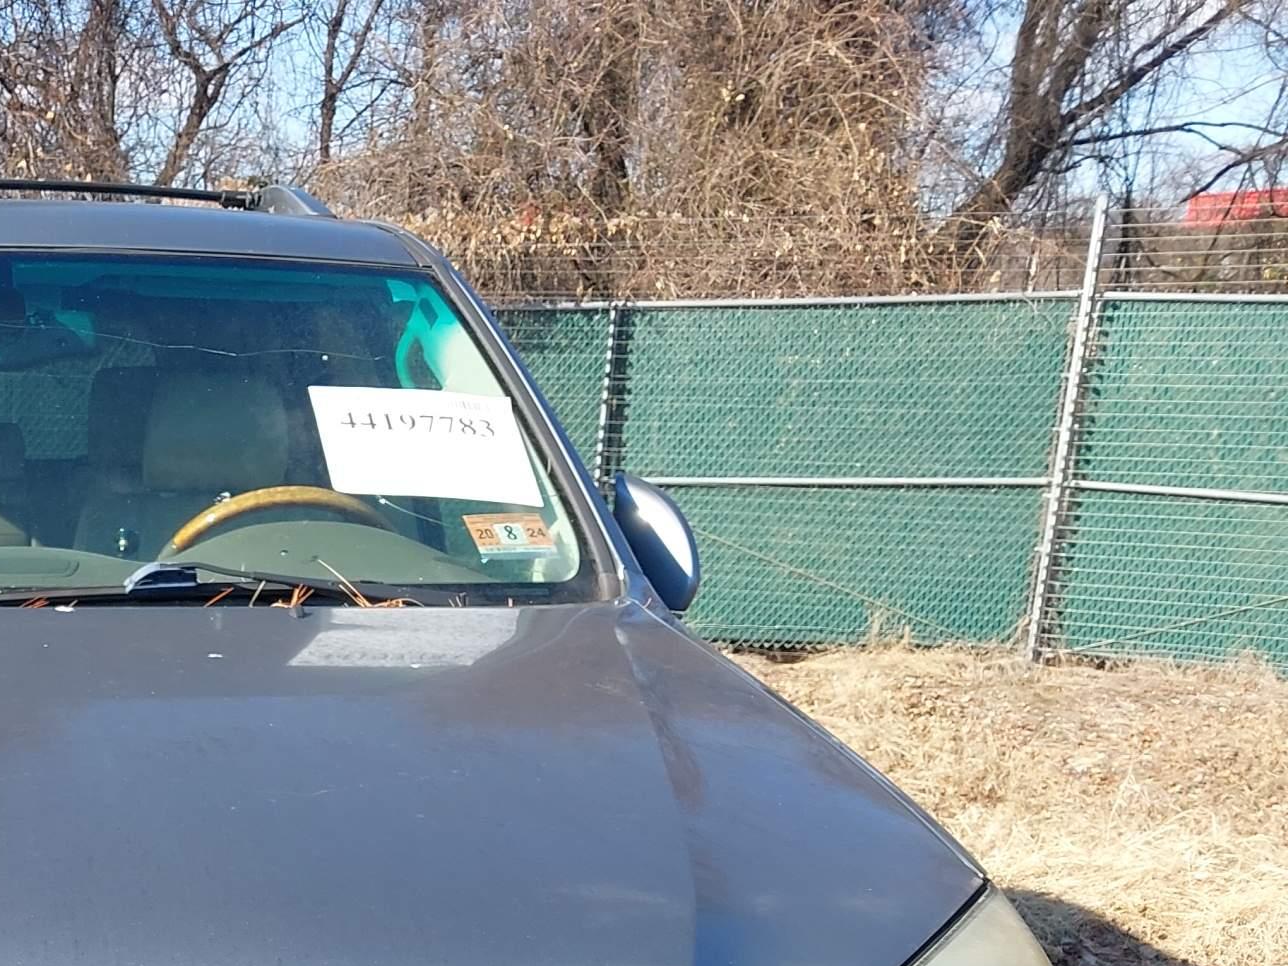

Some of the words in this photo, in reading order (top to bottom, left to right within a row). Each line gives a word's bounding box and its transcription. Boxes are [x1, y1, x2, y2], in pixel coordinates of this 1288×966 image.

[340, 411, 496, 437] 44197783
[476, 528, 494, 540] 20
[503, 525, 518, 541] 8
[527, 527, 546, 538] 24
